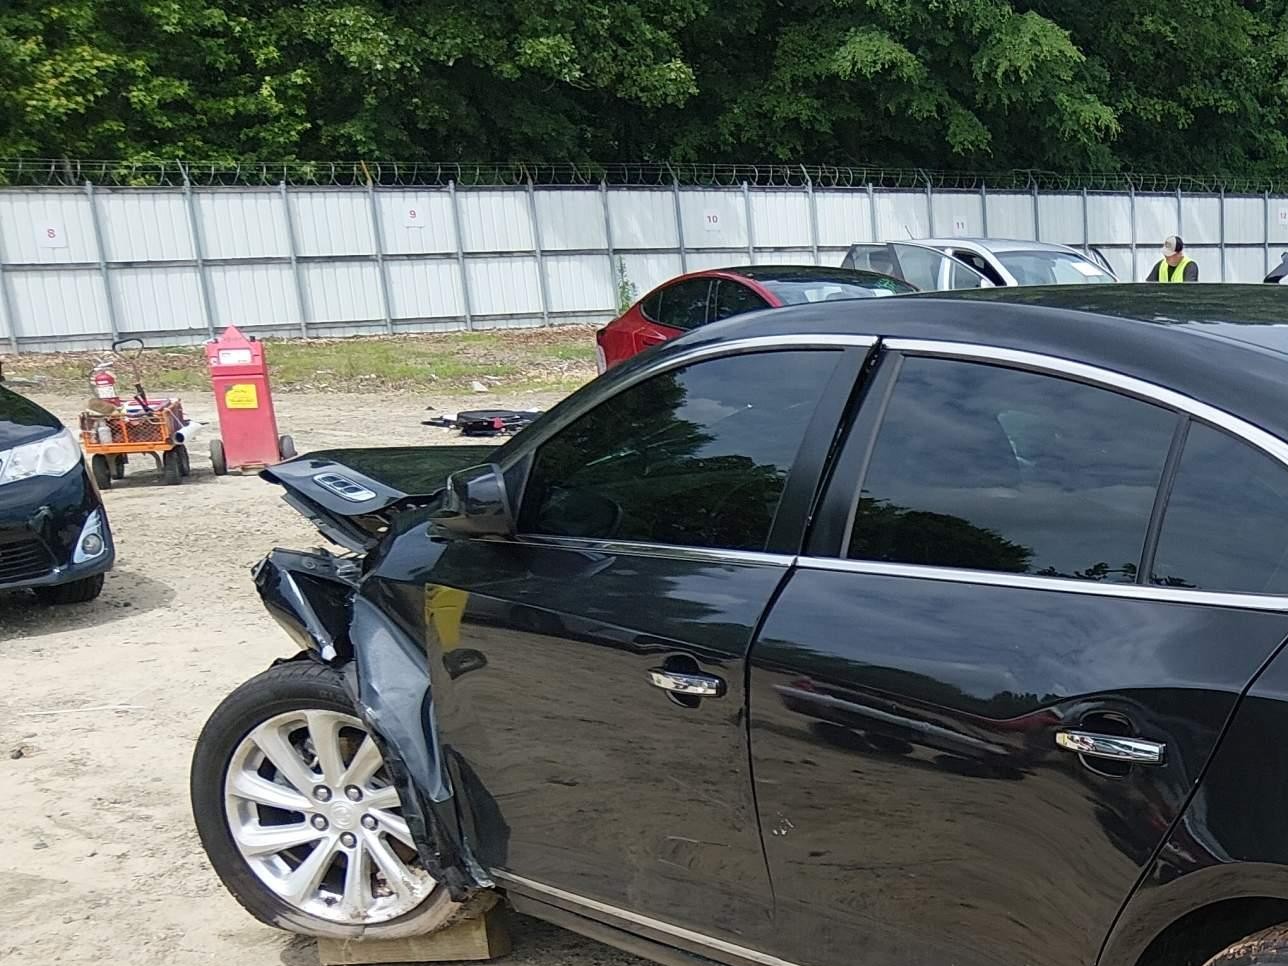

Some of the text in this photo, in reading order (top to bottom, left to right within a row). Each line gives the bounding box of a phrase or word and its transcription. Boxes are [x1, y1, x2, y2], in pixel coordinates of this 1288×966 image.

[409, 209, 417, 219] 9
[706, 215, 718, 224] 10
[956, 221, 965, 230] 11
